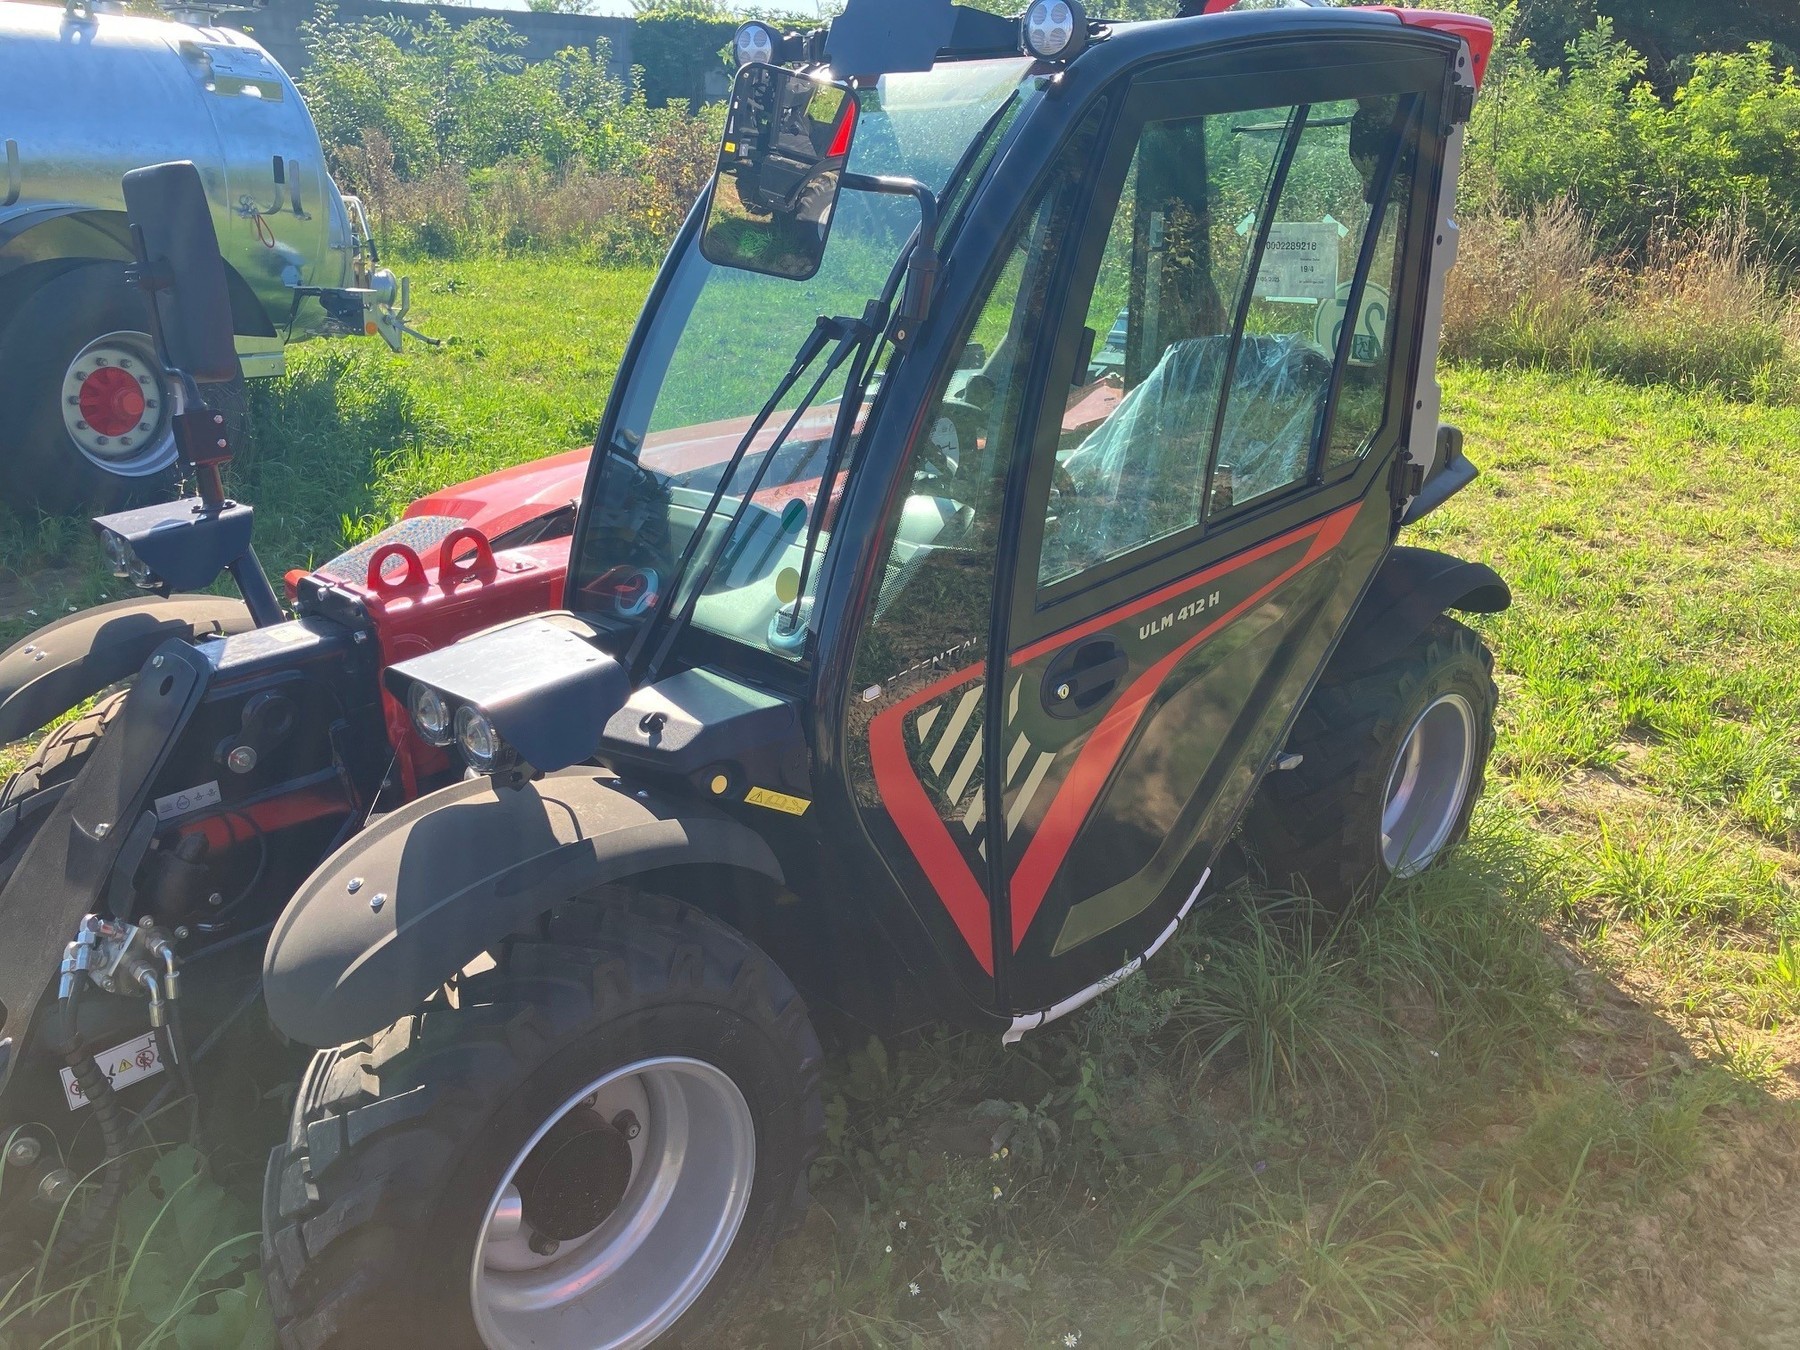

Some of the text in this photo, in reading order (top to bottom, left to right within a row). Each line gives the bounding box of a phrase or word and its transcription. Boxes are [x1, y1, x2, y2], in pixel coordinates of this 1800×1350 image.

[1139, 590, 1220, 640] ULM 412 H
